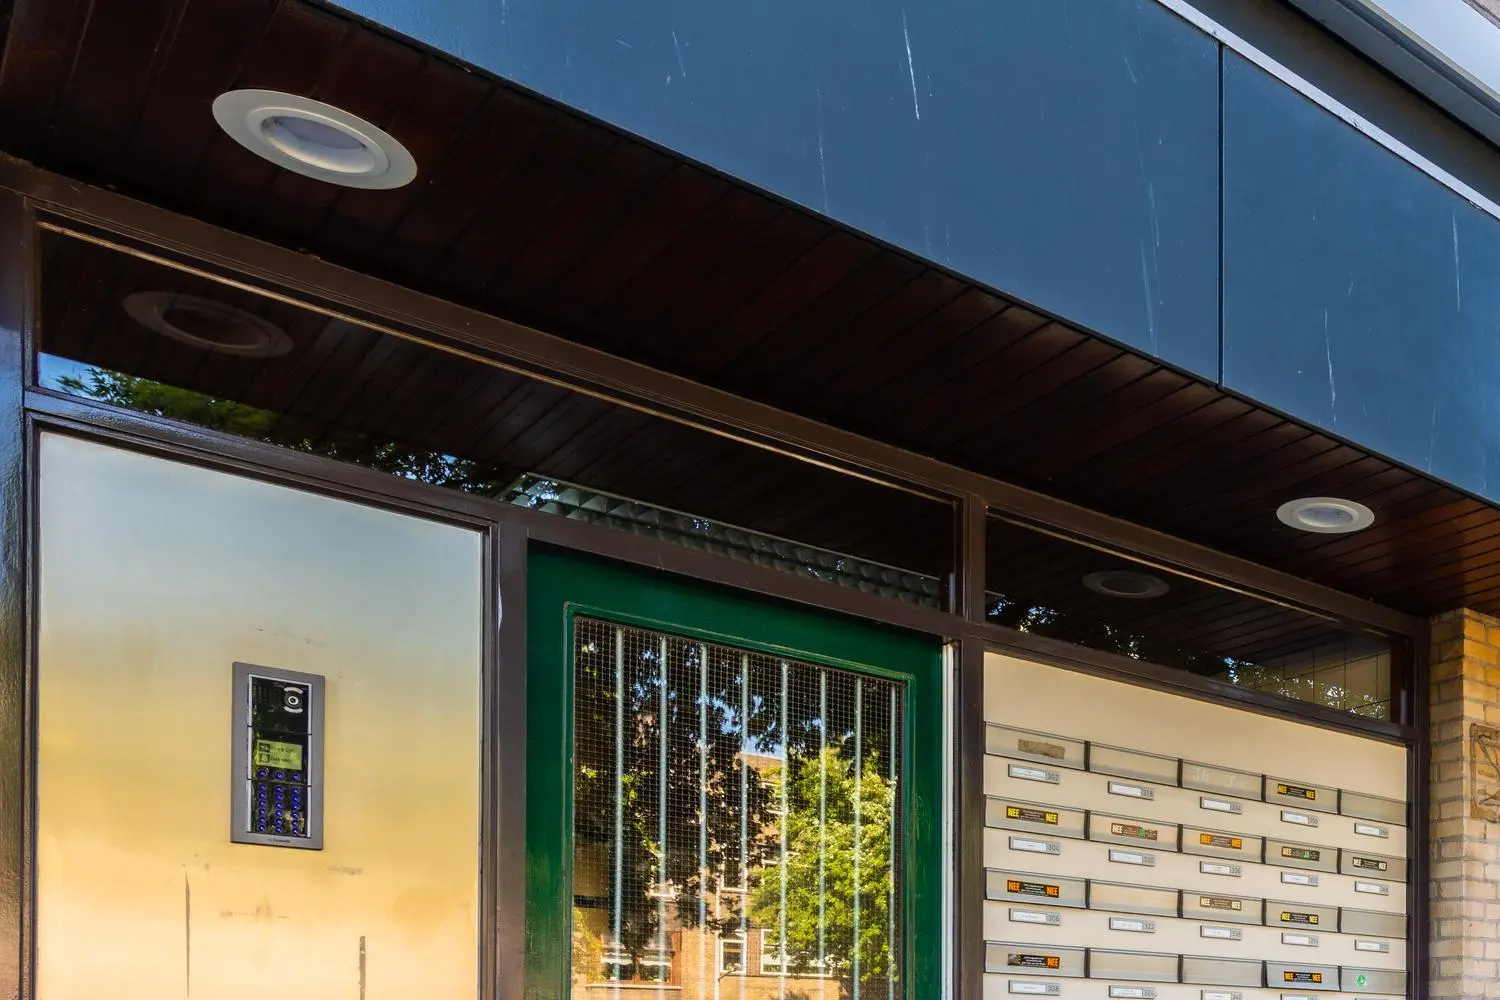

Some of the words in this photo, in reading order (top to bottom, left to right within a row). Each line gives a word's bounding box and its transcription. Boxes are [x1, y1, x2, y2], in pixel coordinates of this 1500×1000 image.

[1008, 808, 1020, 818] NEE
[1046, 814, 1057, 823] NEE
[1112, 824, 1123, 834] NEE
[1008, 881, 1021, 891] NEE
[1046, 887, 1058, 897] NEE
[1047, 957, 1059, 967] NEE
